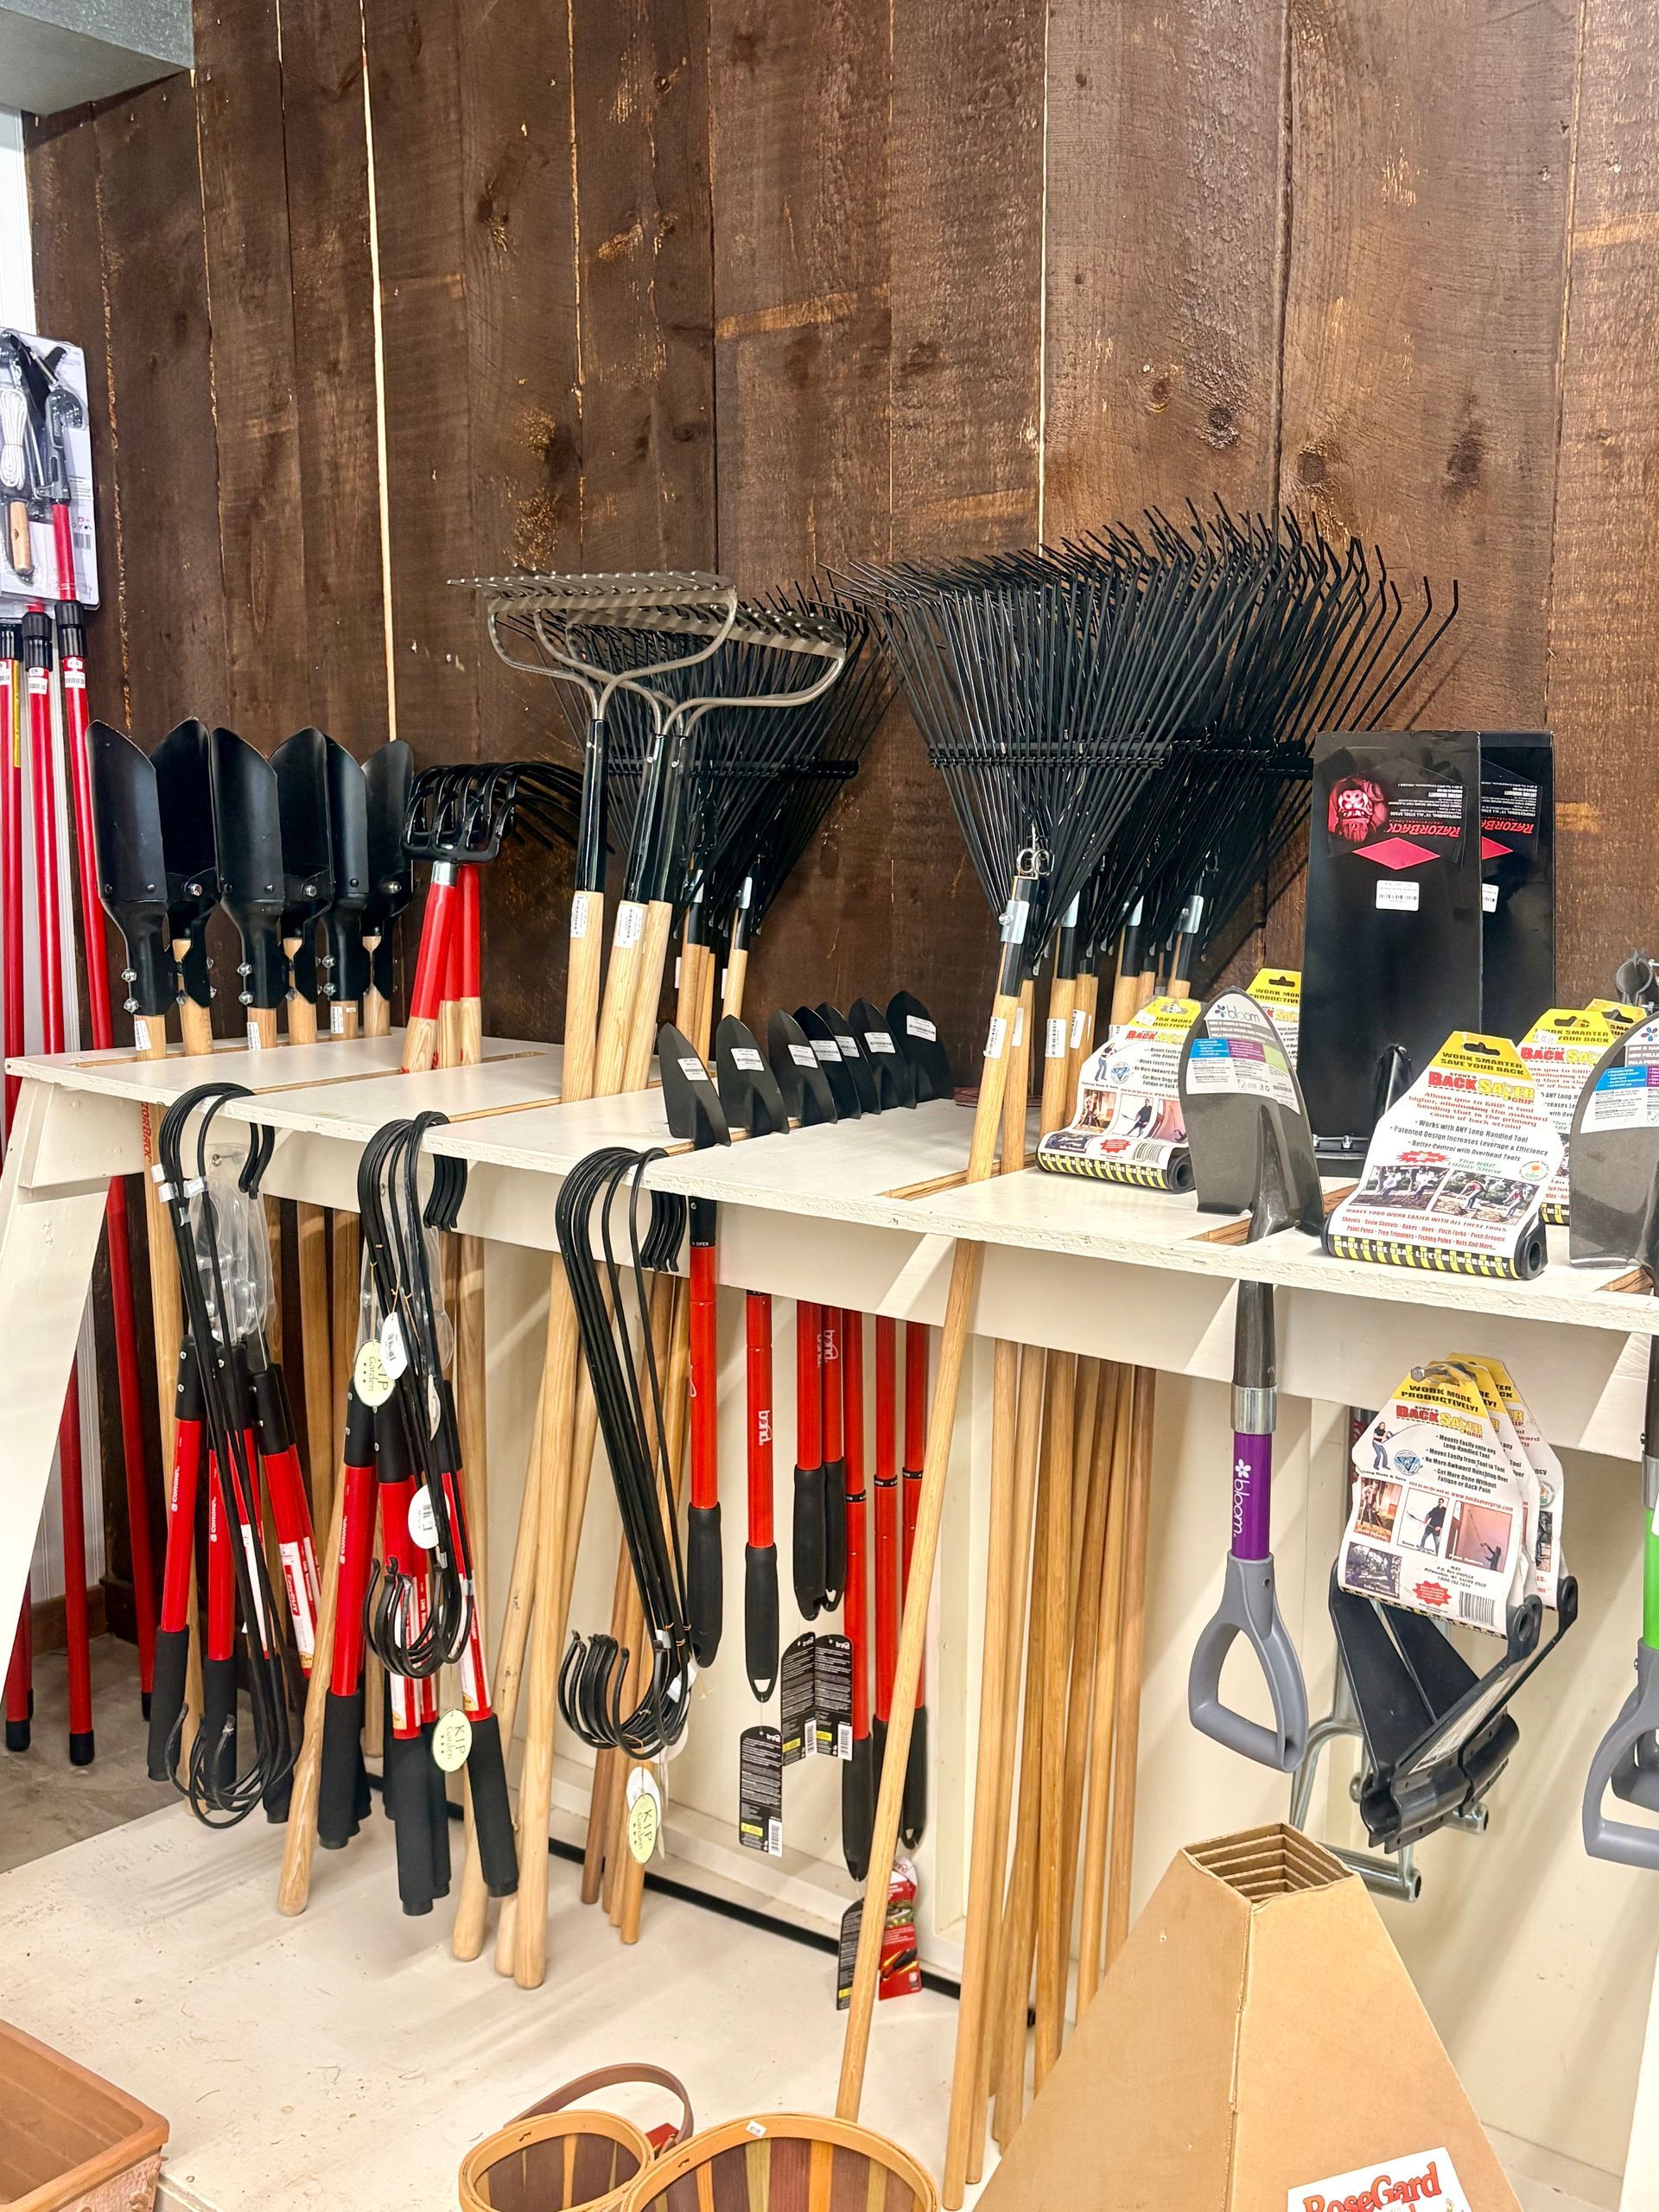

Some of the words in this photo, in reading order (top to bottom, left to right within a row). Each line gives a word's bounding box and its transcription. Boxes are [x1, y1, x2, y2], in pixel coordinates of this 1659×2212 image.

[1386, 823, 1461, 838] RAZORBACK
[1227, 1005, 1260, 1023] bloom
[1442, 1052, 1472, 1062] WORK
[1475, 1057, 1522, 1069] SMARTER
[1521, 1046, 1565, 1061] BACK
[1440, 1058, 1465, 1067] SAVE
[1468, 1062, 1494, 1071] YOUR
[1496, 1066, 1524, 1076] BACK
[1428, 1071, 1478, 1090] BACK
[1424, 1092, 1452, 1101] Allows
[1416, 1103, 1451, 1113] bending
[1502, 1116, 1537, 1128] primary
[1440, 1101, 1488, 1113] eliminating
[1508, 1112, 1548, 1122] awkward
[1419, 1120, 1440, 1129] Works
[1440, 1123, 1454, 1132] with
[1514, 1135, 1529, 1143] Tool
[1491, 1122, 1522, 1130] strain!
[1394, 1125, 1423, 1137] Patented
[1424, 1130, 1446, 1141] Design
[1446, 1135, 1478, 1146] Increases
[1479, 1140, 1510, 1151] Leverage
[1516, 1145, 1548, 1157] Efficiency
[1412, 1140, 1432, 1148] Better
[1433, 1142, 1456, 1152] Control
[1471, 1148, 1503, 1160] Overhead
[1503, 1153, 1522, 1162] Tools
[1341, 1216, 1362, 1224] Shovels
[1438, 1227, 1452, 1236] Pitch
[1452, 1229, 1467, 1237] Forks
[1484, 1234, 1506, 1243] Brooms
[1389, 1230, 1414, 1240] Trimmers
[1418, 1235, 1437, 1243] Fishing
[1334, 1240, 1359, 1249] MADE
[1372, 1245, 1389, 1254] THE
[1389, 1248, 1408, 1257] USA
[1415, 1251, 1456, 1262] LIFETIME
[1457, 1255, 1508, 1270] WARRANTY
[823, 1330, 839, 1363] bond
[1401, 1391, 1478, 1413] PRODUCTIVELY!
[1408, 1385, 1445, 1395] WORK
[1446, 1389, 1472, 1403] MORE
[1395, 1405, 1440, 1423] BACK
[759, 1410, 773, 1446] bond
[1439, 1434, 1459, 1445] Mounts
[1459, 1438, 1475, 1448] Easily
[1475, 1443, 1487, 1452] onto
[1487, 1446, 1497, 1455] any
[1479, 1450, 1491, 1459] Tool
[1429, 1448, 1446, 1458] Moves
[1447, 1451, 1464, 1462] Easily
[1464, 1454, 1477, 1465] from
[1477, 1458, 1488, 1468] Tool
[1494, 1464, 1505, 1473] Tool
[1510, 1459, 1522, 1468] Tool
[1433, 1459, 1447, 1467] More
[1447, 1461, 1471, 1472] Awkward
[1497, 1474, 1509, 1484] Over
[1437, 1468, 1446, 1477] Get
[1446, 1471, 1460, 1479] More
[1461, 1473, 1475, 1483] Done
[1475, 1476, 1497, 1489] Without
[1438, 1475, 1457, 1486] Fatigue
[1465, 1481, 1478, 1491] Back
[1478, 1485, 1491, 1495] Pain
[1234, 1478, 1250, 1535] bloom
[455, 1724, 466, 1754] KIP
[644, 1808, 652, 1842] KIP
[1302, 2161, 1442, 2212] RoseGard
